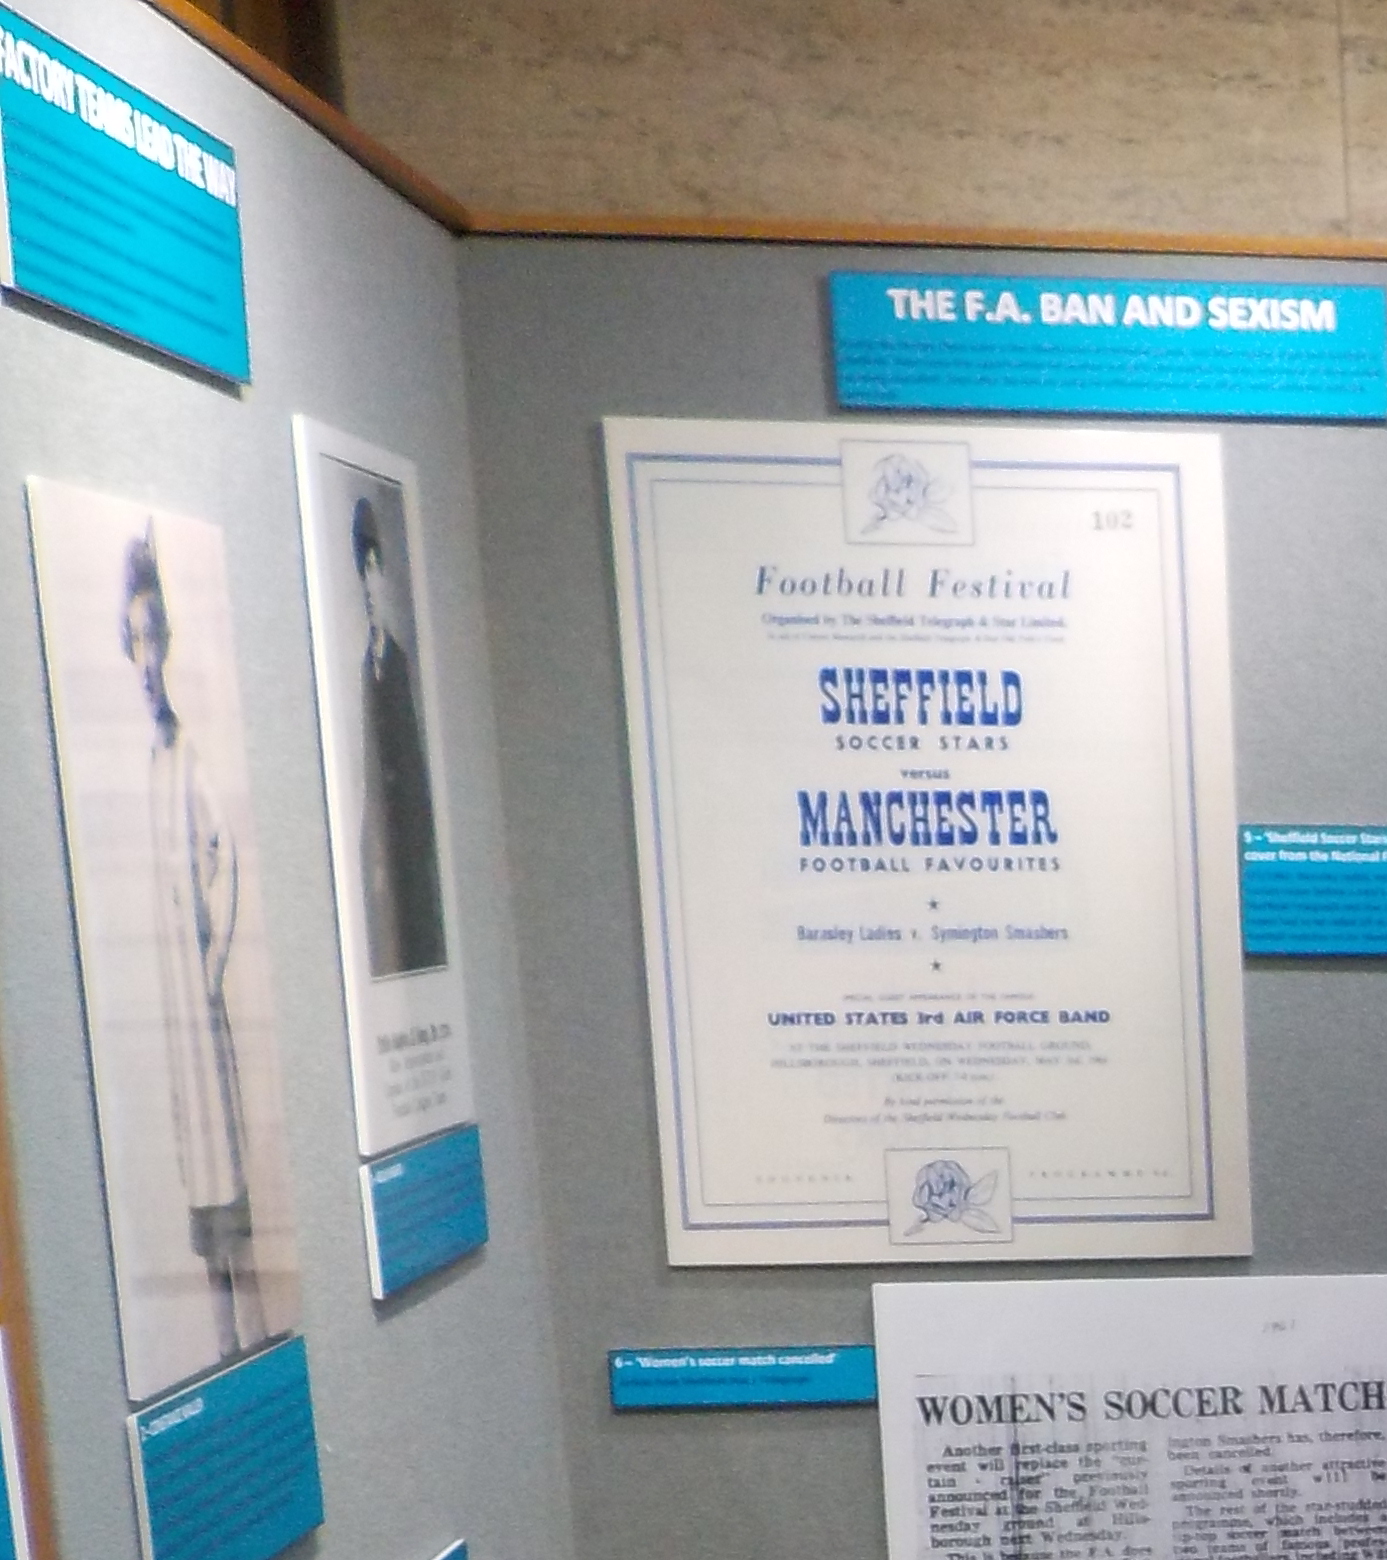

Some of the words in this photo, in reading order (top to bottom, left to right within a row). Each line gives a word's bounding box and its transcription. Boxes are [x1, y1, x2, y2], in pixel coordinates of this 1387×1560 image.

[134, 108, 175, 171] LEAD
[173, 132, 206, 189] THE
[202, 151, 236, 208] WAY
[887, 289, 957, 321] THE
[965, 291, 1032, 323] F.A.
[1042, 293, 1114, 325] BAN
[1123, 296, 1201, 328] AND
[1209, 298, 1337, 332] SEXISM
[1091, 508, 1134, 532] 102
[755, 564, 906, 598] Football
[928, 566, 1072, 600] Festival
[818, 665, 1024, 728] SHEFFIELD
[835, 734, 921, 751] SOCCER
[938, 733, 1010, 751] STARS
[900, 768, 950, 780] versus
[797, 789, 1060, 847] MANCHESTER
[1320, 832, 1357, 845] Soccer
[799, 857, 911, 873] FOOTBALL
[924, 856, 1061, 873] FAVOURITES
[1244, 852, 1276, 862] cover
[1278, 849, 1308, 862] from
[1309, 849, 1330, 862] the
[1331, 850, 1381, 863] National
[797, 925, 854, 945] Barnsley
[860, 925, 902, 941] Ladies
[931, 925, 999, 944] Symington
[1005, 924, 1069, 941] Smashers
[767, 1011, 836, 1027] UNITED
[844, 1010, 909, 1027] STATES
[916, 1009, 945, 1026] 3rd
[952, 1009, 986, 1025] AIR
[993, 1009, 1051, 1025] FORCE
[1057, 1008, 1111, 1025] BAND
[698, 1356, 735, 1367] soccer
[738, 1354, 776, 1367] match
[915, 1391, 1088, 1428] WOMEN'S
[1102, 1384, 1244, 1422] SOCCER
[1257, 1379, 1387, 1415] MATCH
[942, 1443, 1004, 1459] Another
[926, 1462, 966, 1473] event
[977, 1458, 1005, 1473] will
[1015, 1457, 1069, 1475] replace
[1079, 1456, 1103, 1468] the
[928, 1490, 1008, 1502] announced
[1017, 1487, 1042, 1500] for
[1053, 1486, 1077, 1499] the
[929, 1501, 988, 1518] Festival
[930, 1519, 981, 1534] nesday
[931, 1533, 993, 1549] borough
